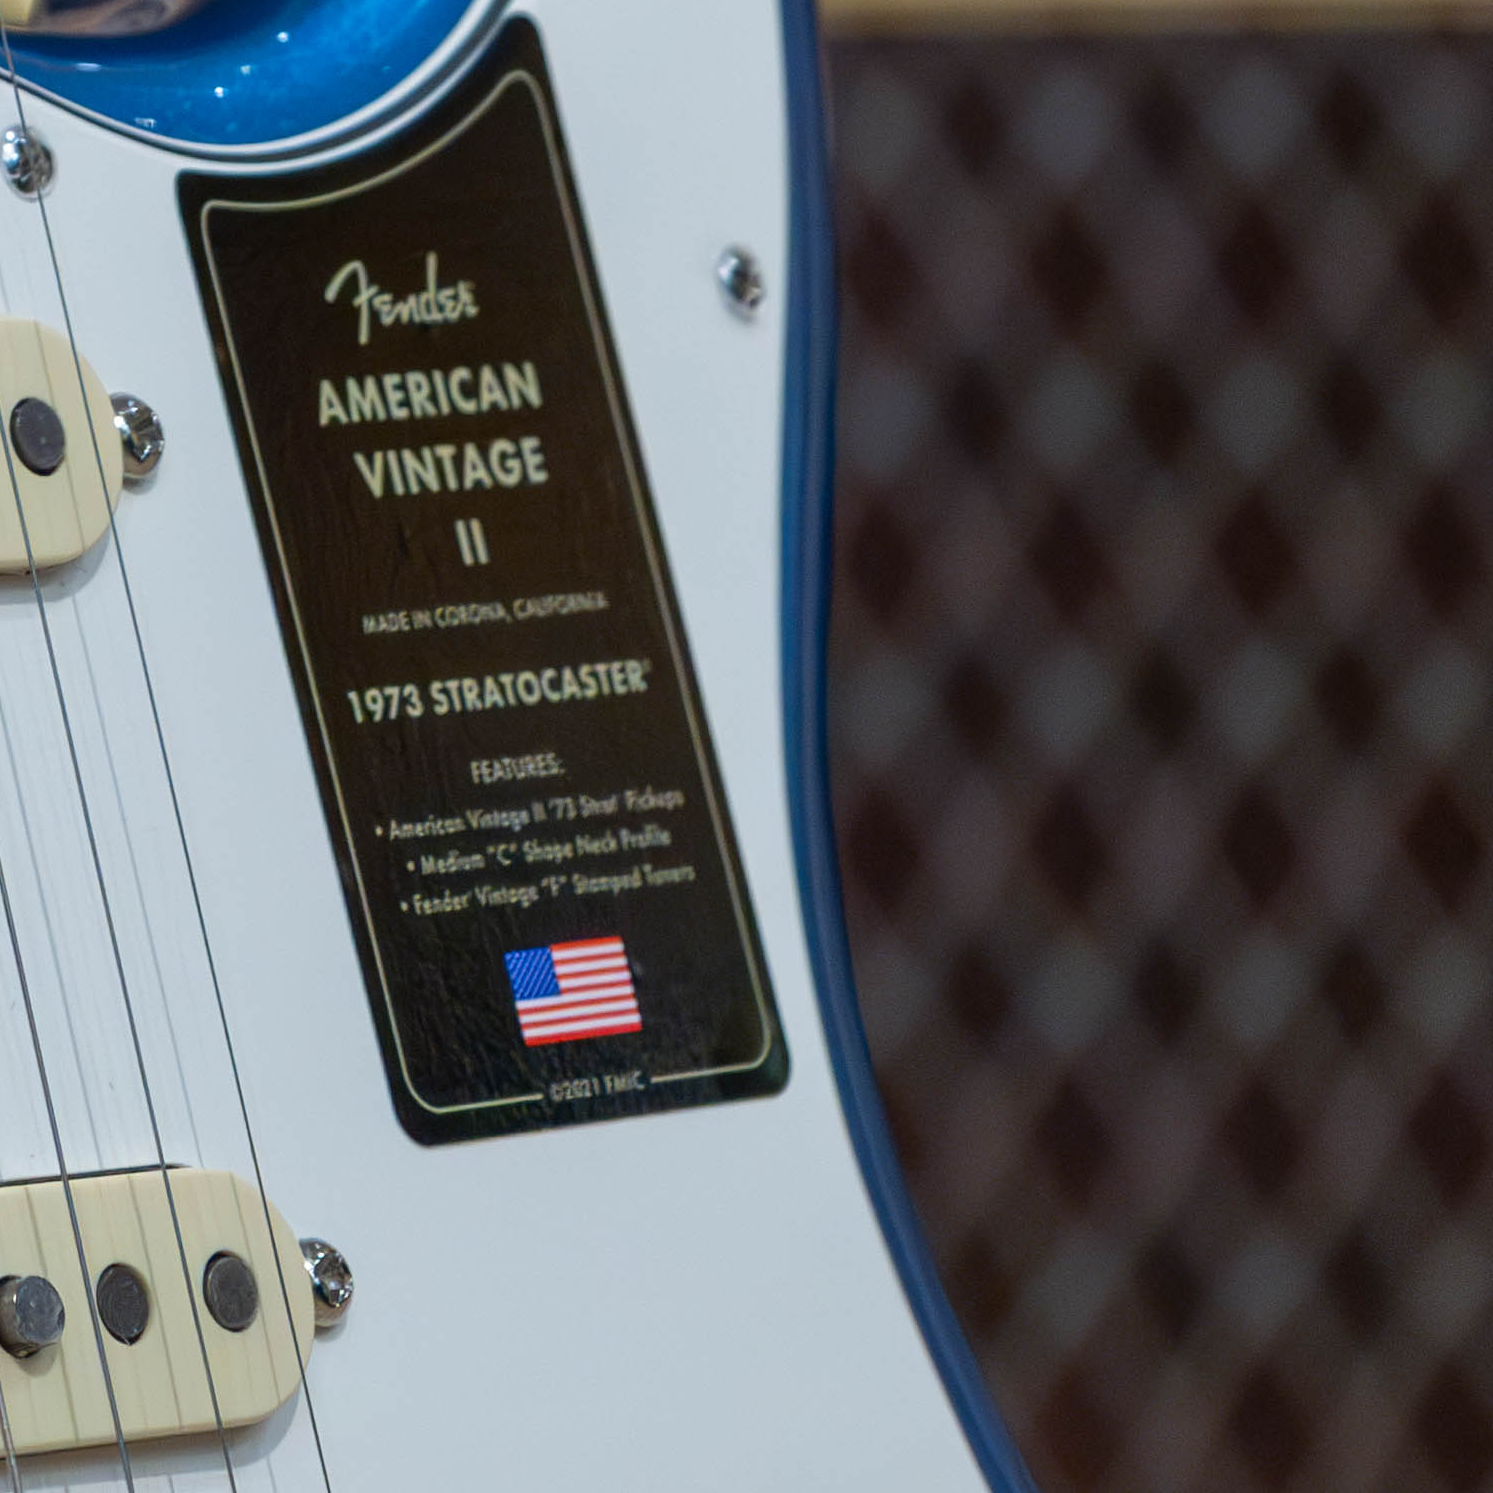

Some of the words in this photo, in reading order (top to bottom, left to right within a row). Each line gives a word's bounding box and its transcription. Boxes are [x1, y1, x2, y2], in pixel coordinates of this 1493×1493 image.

[324, 250, 480, 346] Fender
[318, 360, 543, 428] AMERICAN
[353, 436, 549, 499] VINTAGE
[454, 517, 490, 566] II
[362, 612, 411, 634] MADE
[413, 610, 432, 629] IN
[513, 591, 610, 620] CALIFORNIA
[347, 683, 425, 724] 1973
[389, 814, 466, 841] American
[466, 809, 531, 833] Vintage
[624, 783, 685, 810] Pickups
[420, 850, 485, 875] Medium
[522, 838, 573, 863] Shape
[575, 829, 617, 856] Neck
[619, 823, 672, 851] Profile
[475, 885, 539, 908] Vintage
